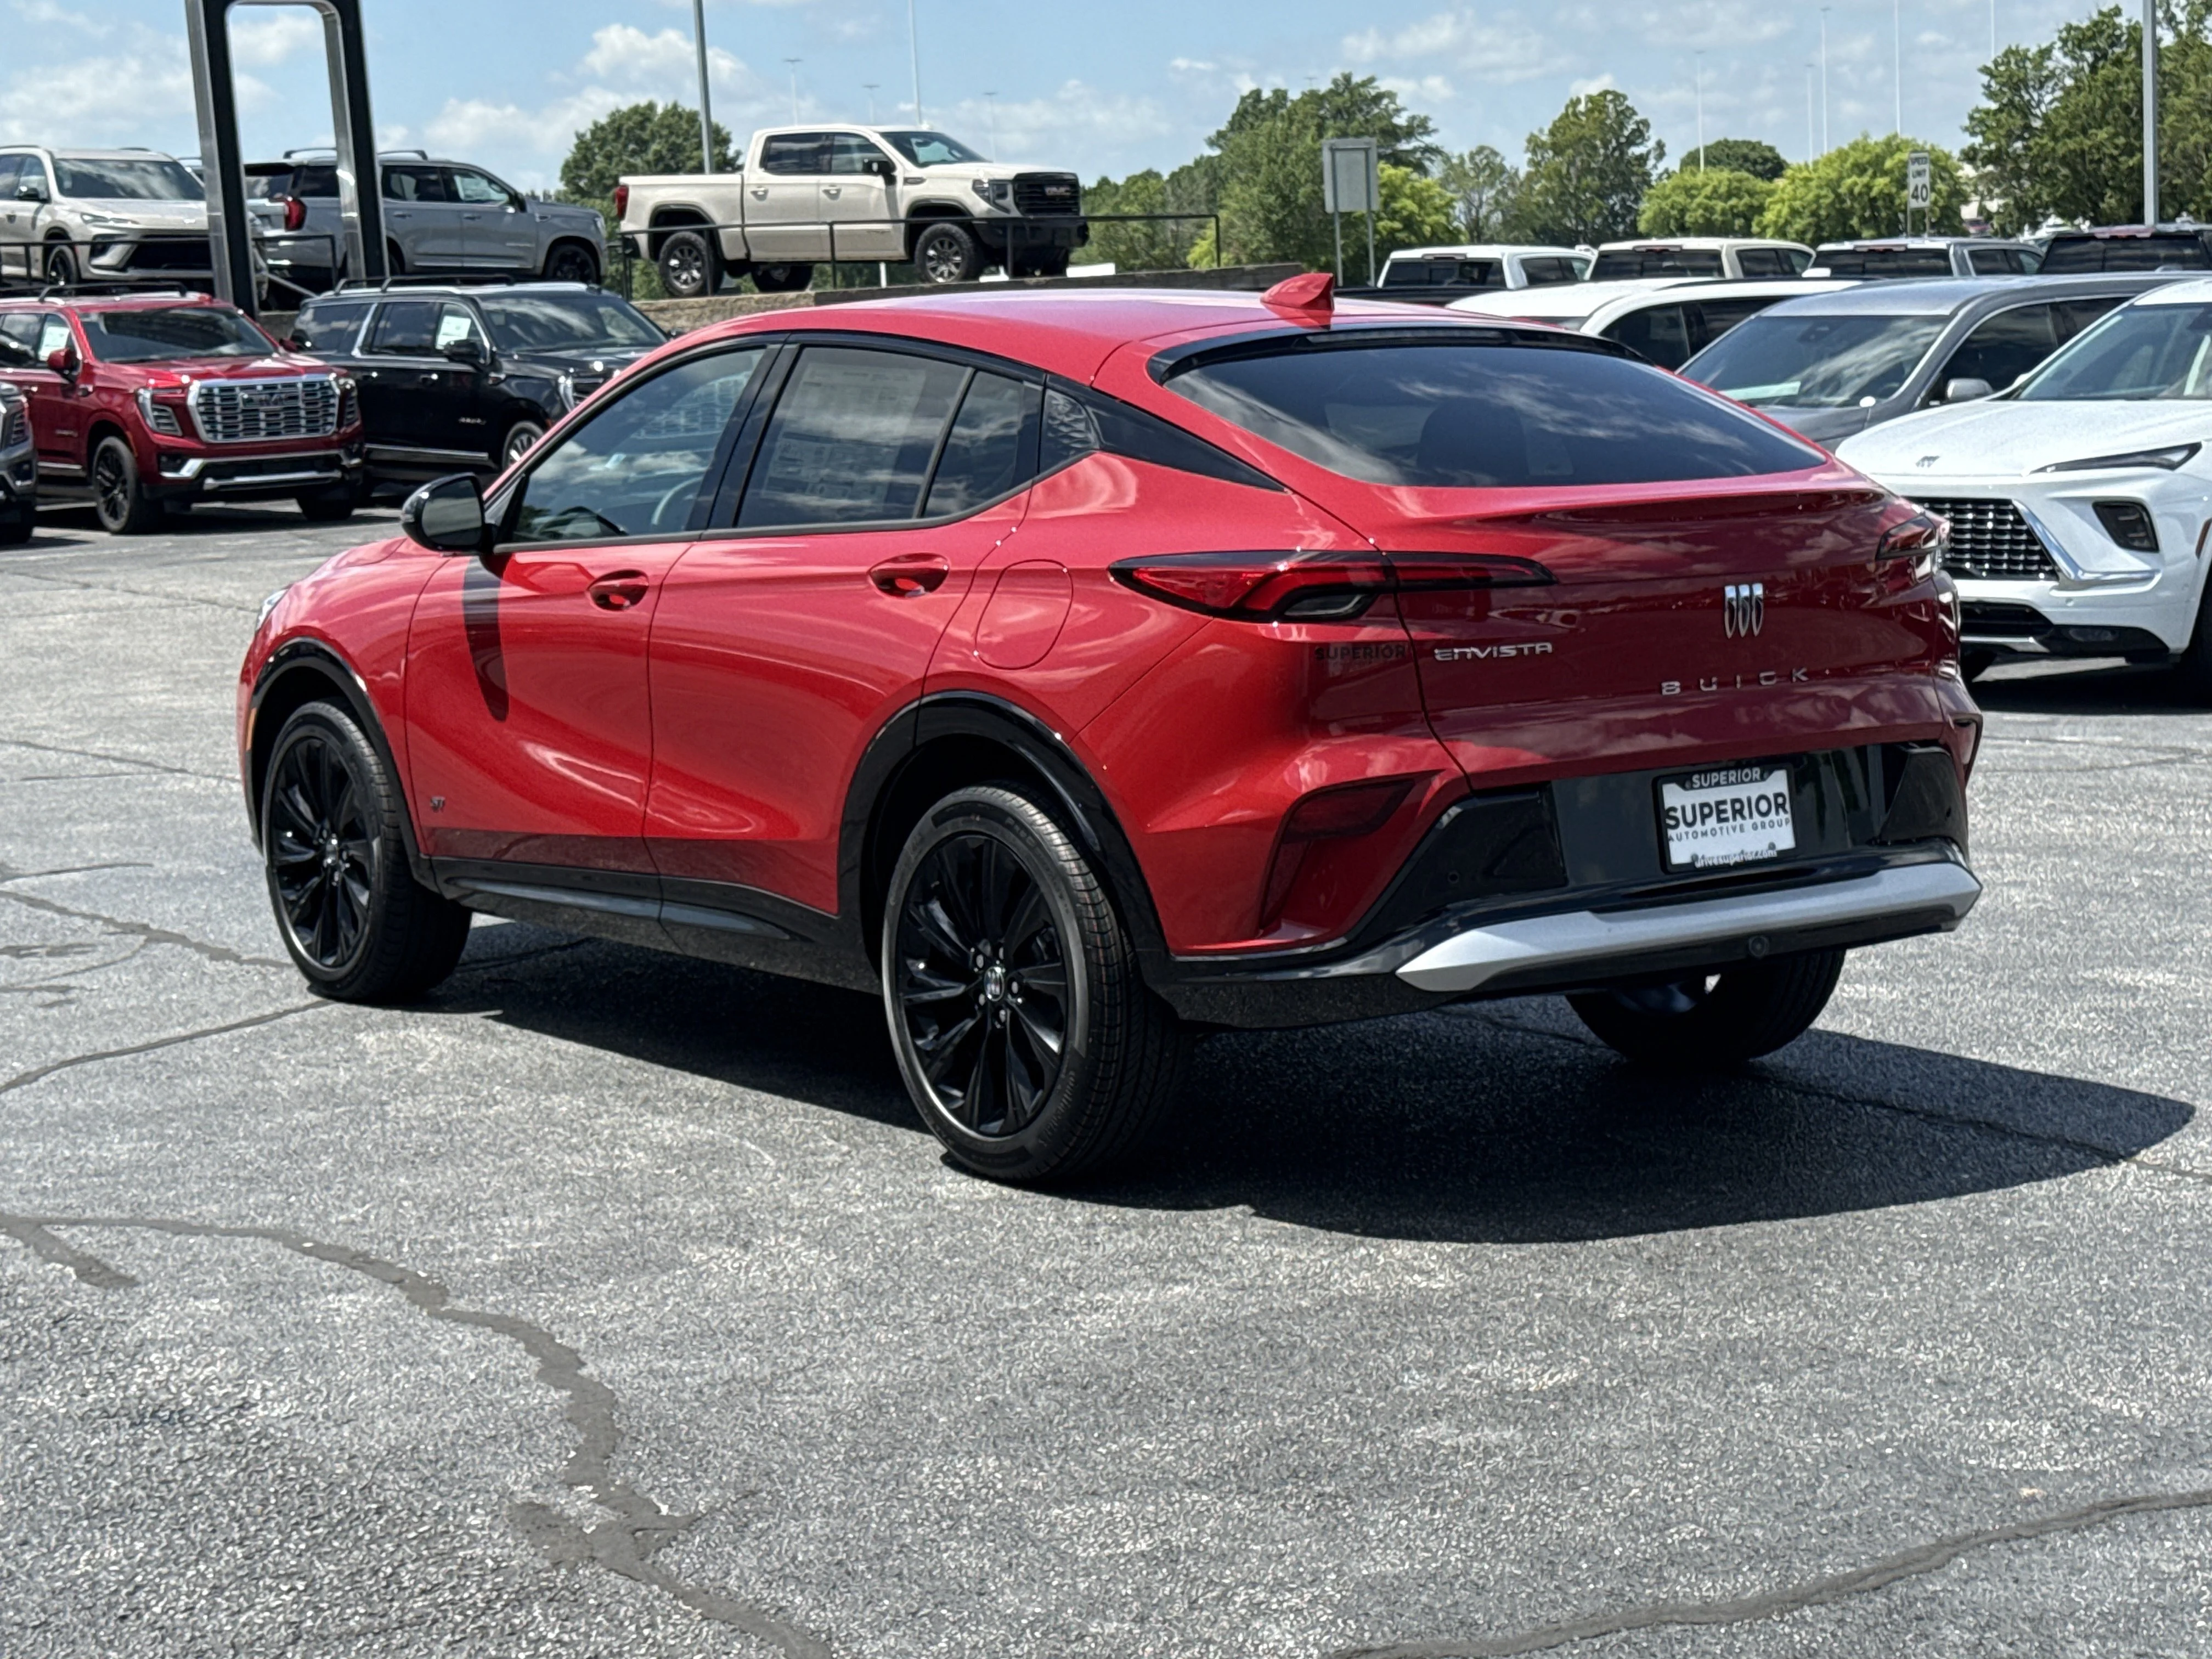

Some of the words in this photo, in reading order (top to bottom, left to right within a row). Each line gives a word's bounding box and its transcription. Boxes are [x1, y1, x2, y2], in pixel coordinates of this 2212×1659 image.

[1911, 184, 1928, 203] 40
[1314, 644, 1406, 661] SUPERIOR
[1434, 641, 1553, 662] ENVISTA
[1661, 667, 1809, 696] BUICK
[1691, 766, 1762, 788] SUPERIOR
[1664, 792, 1789, 830] SUPERIOR
[1668, 823, 1745, 842] AUTOMOTIVE
[1751, 817, 1791, 832] GROUP
